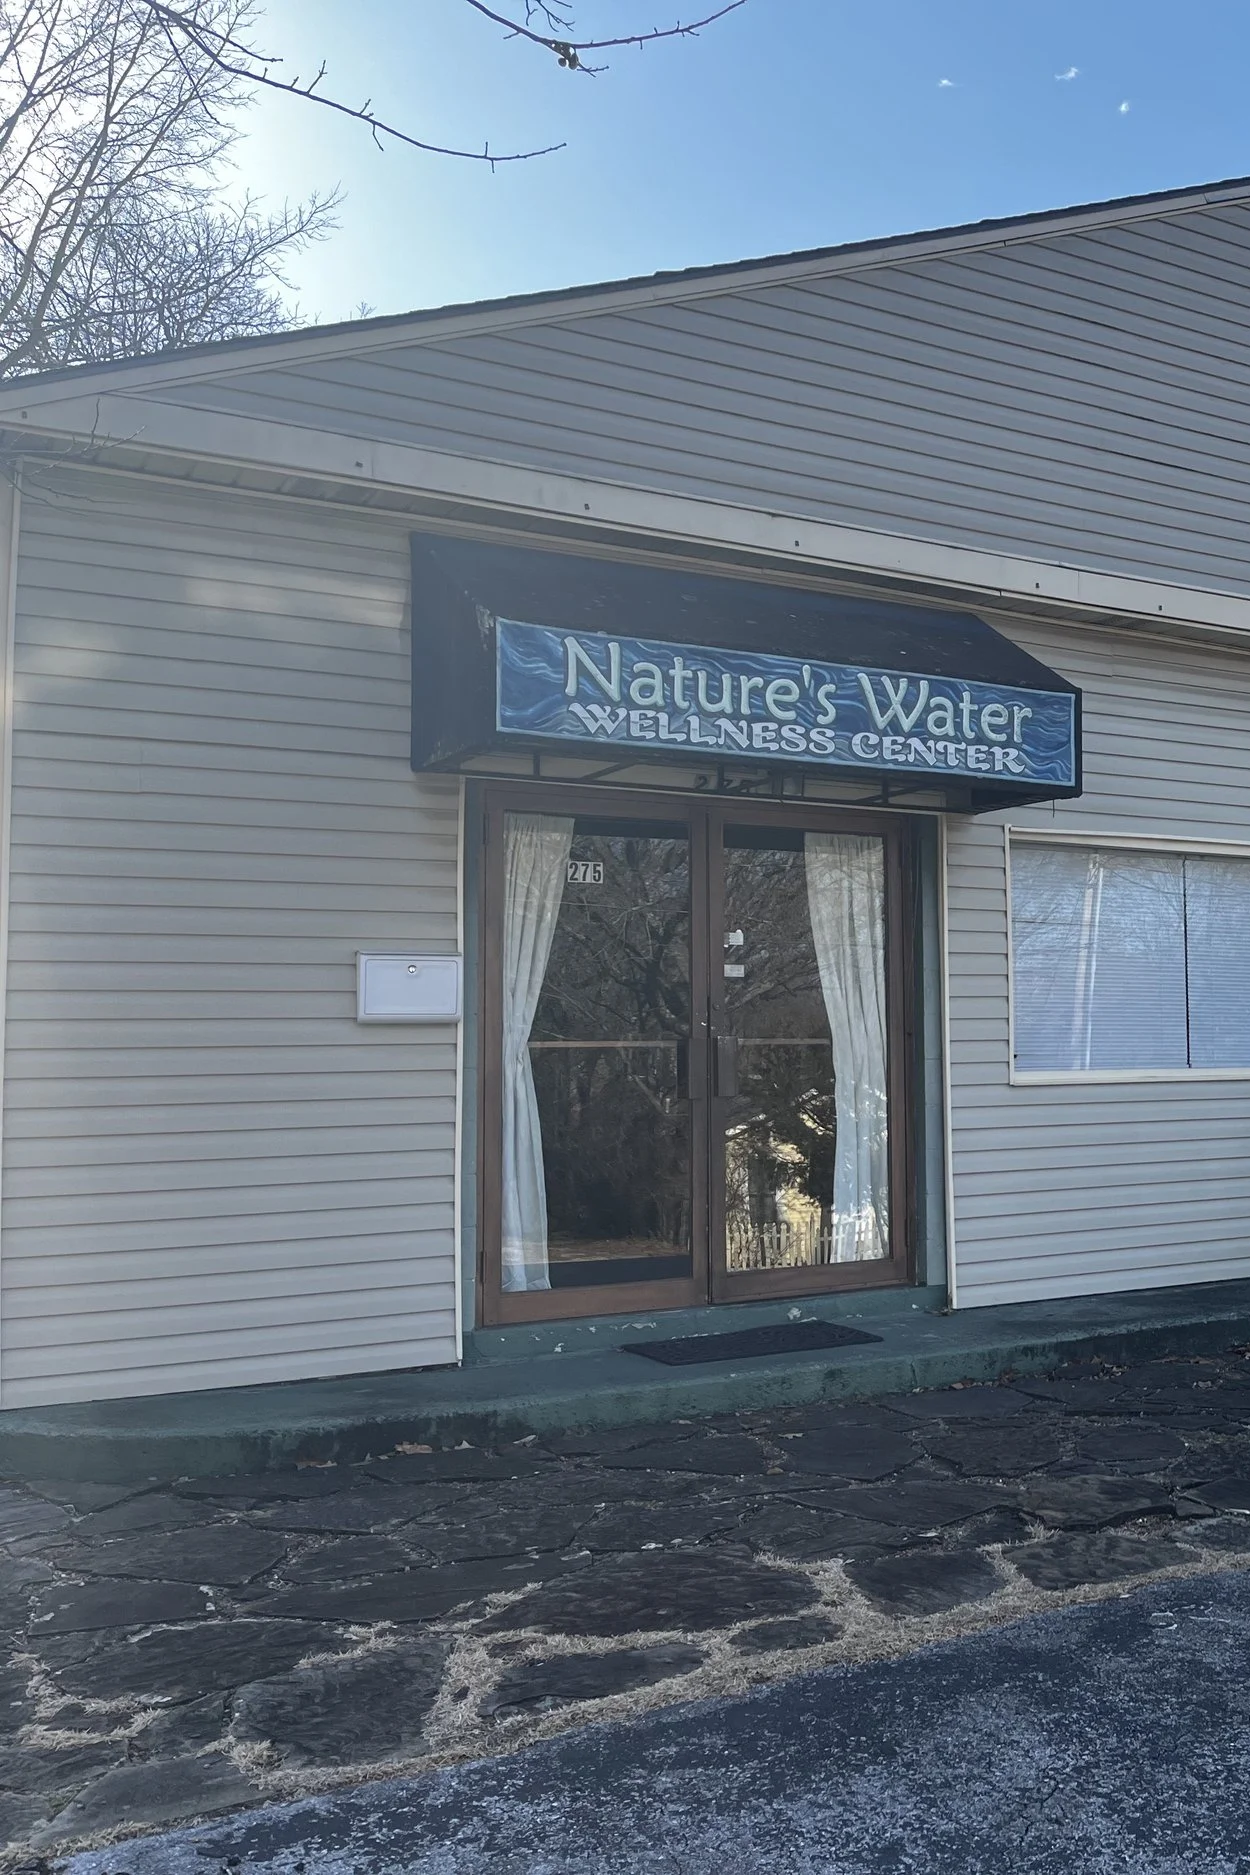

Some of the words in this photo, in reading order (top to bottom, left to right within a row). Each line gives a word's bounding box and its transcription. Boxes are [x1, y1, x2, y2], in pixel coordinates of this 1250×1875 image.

[563, 636, 836, 724] Nature's
[857, 673, 1033, 743] Water
[568, 702, 836, 754] WELLNESS
[851, 732, 1026, 774] CENTER
[568, 861, 602, 882] 275
